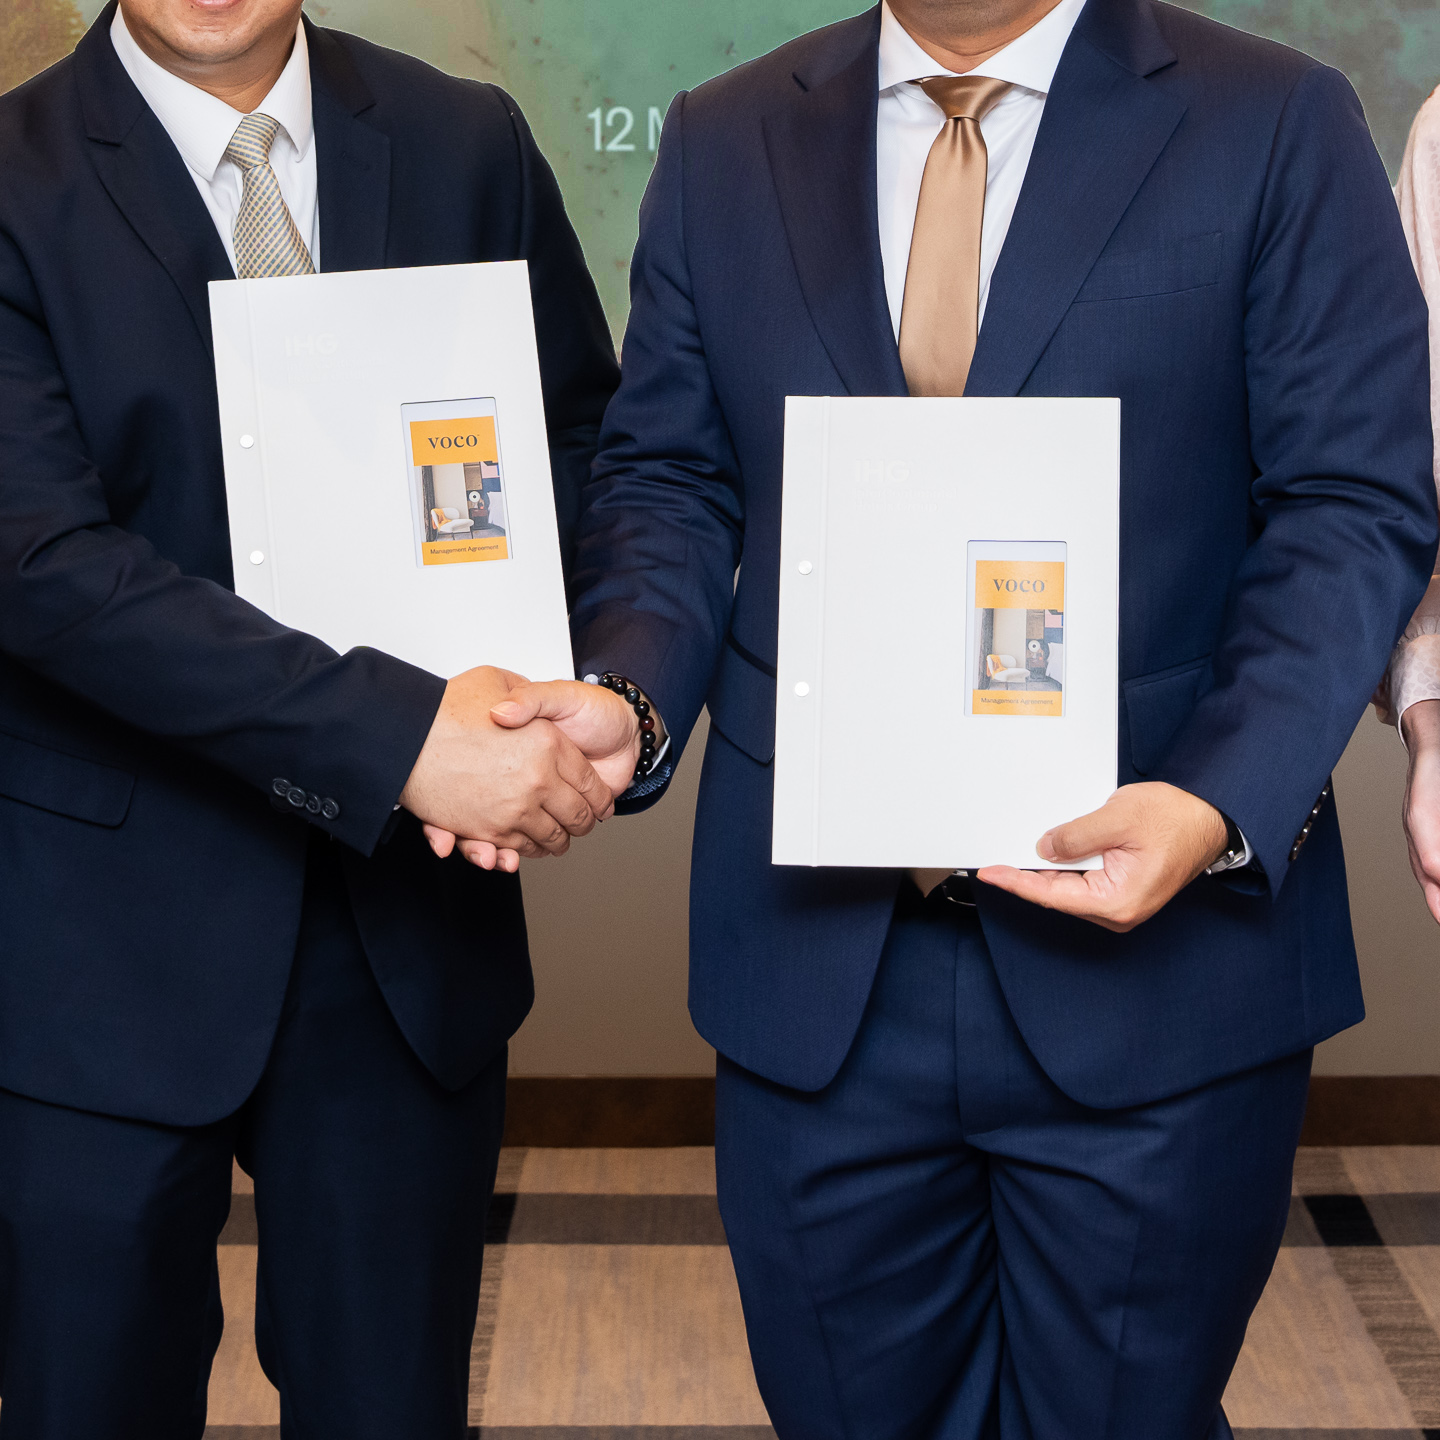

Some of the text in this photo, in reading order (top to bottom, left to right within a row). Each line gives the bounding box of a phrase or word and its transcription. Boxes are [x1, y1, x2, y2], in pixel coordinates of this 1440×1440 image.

[587, 106, 636, 152] 12
[430, 544, 499, 555] Management Agreement
